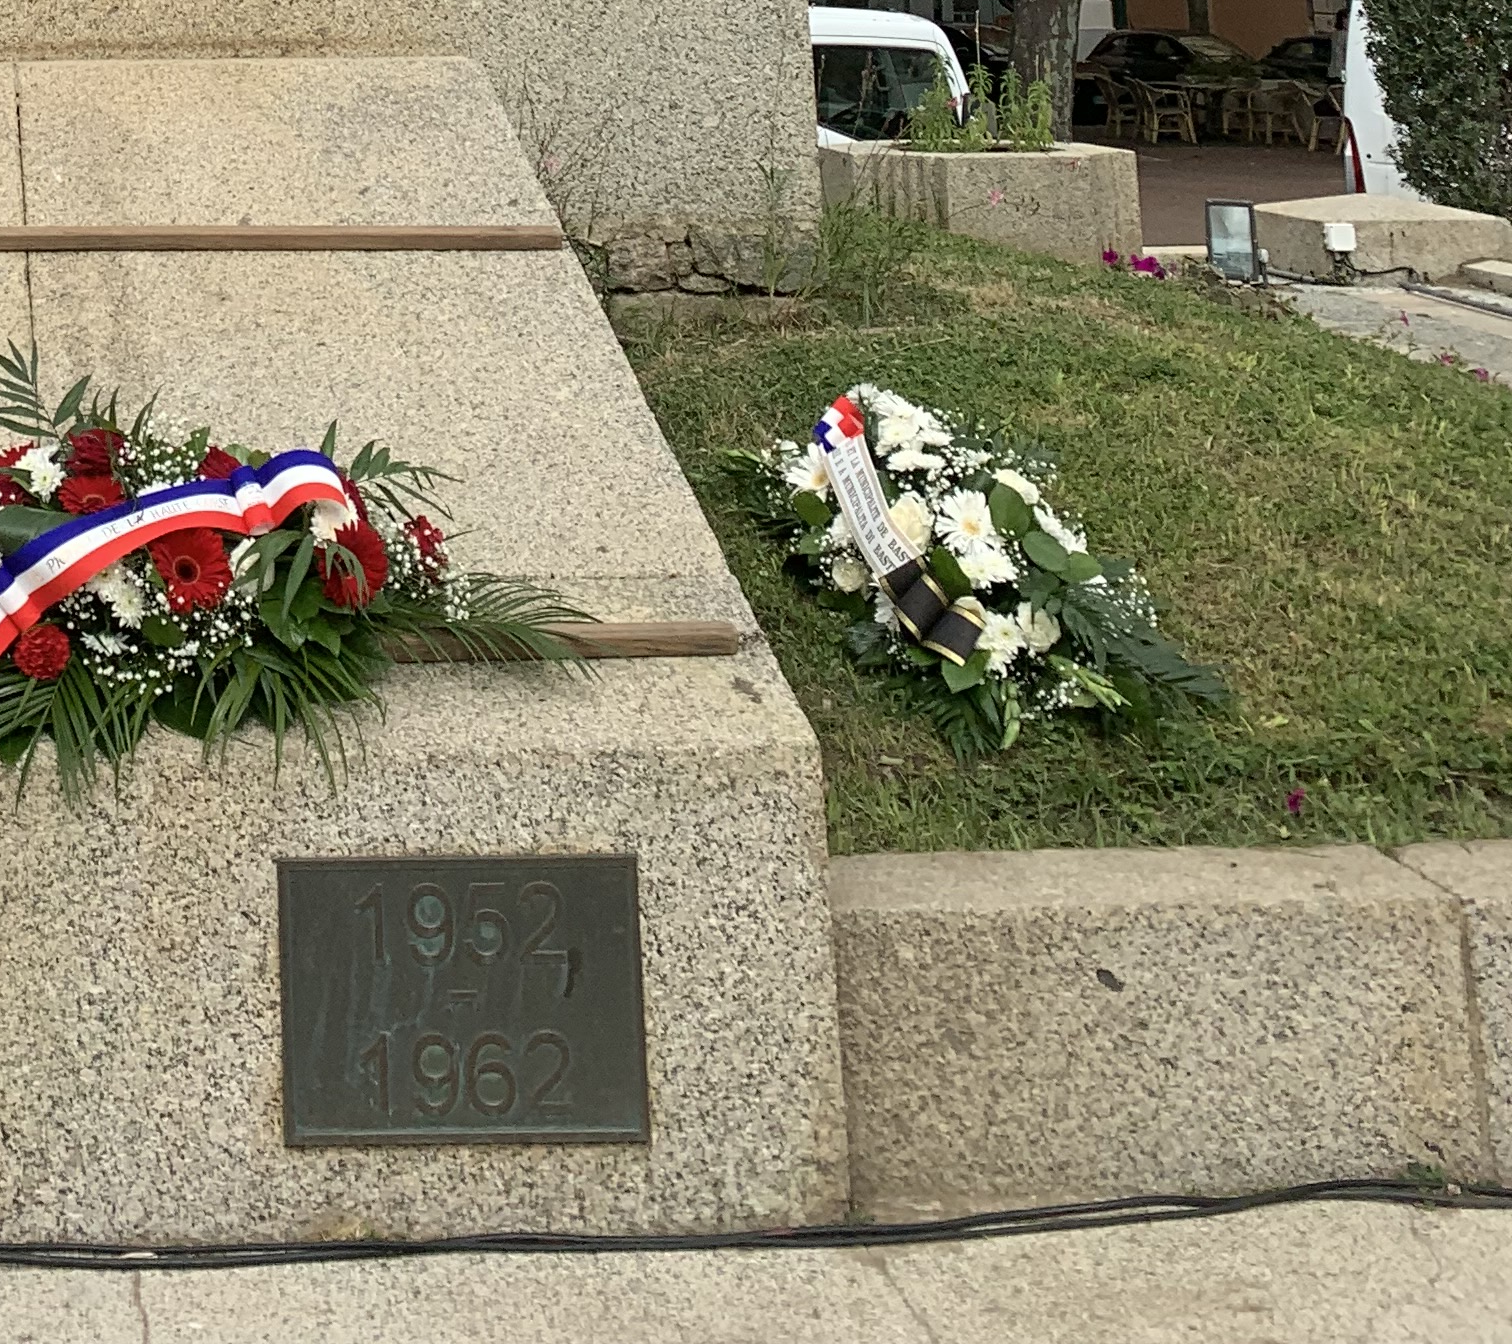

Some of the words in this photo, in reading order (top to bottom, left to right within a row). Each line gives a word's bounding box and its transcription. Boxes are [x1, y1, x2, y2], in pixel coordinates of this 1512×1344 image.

[101, 522, 121, 539] DE
[149, 501, 192, 520] HAUTE
[358, 1028, 573, 1119] 1962
